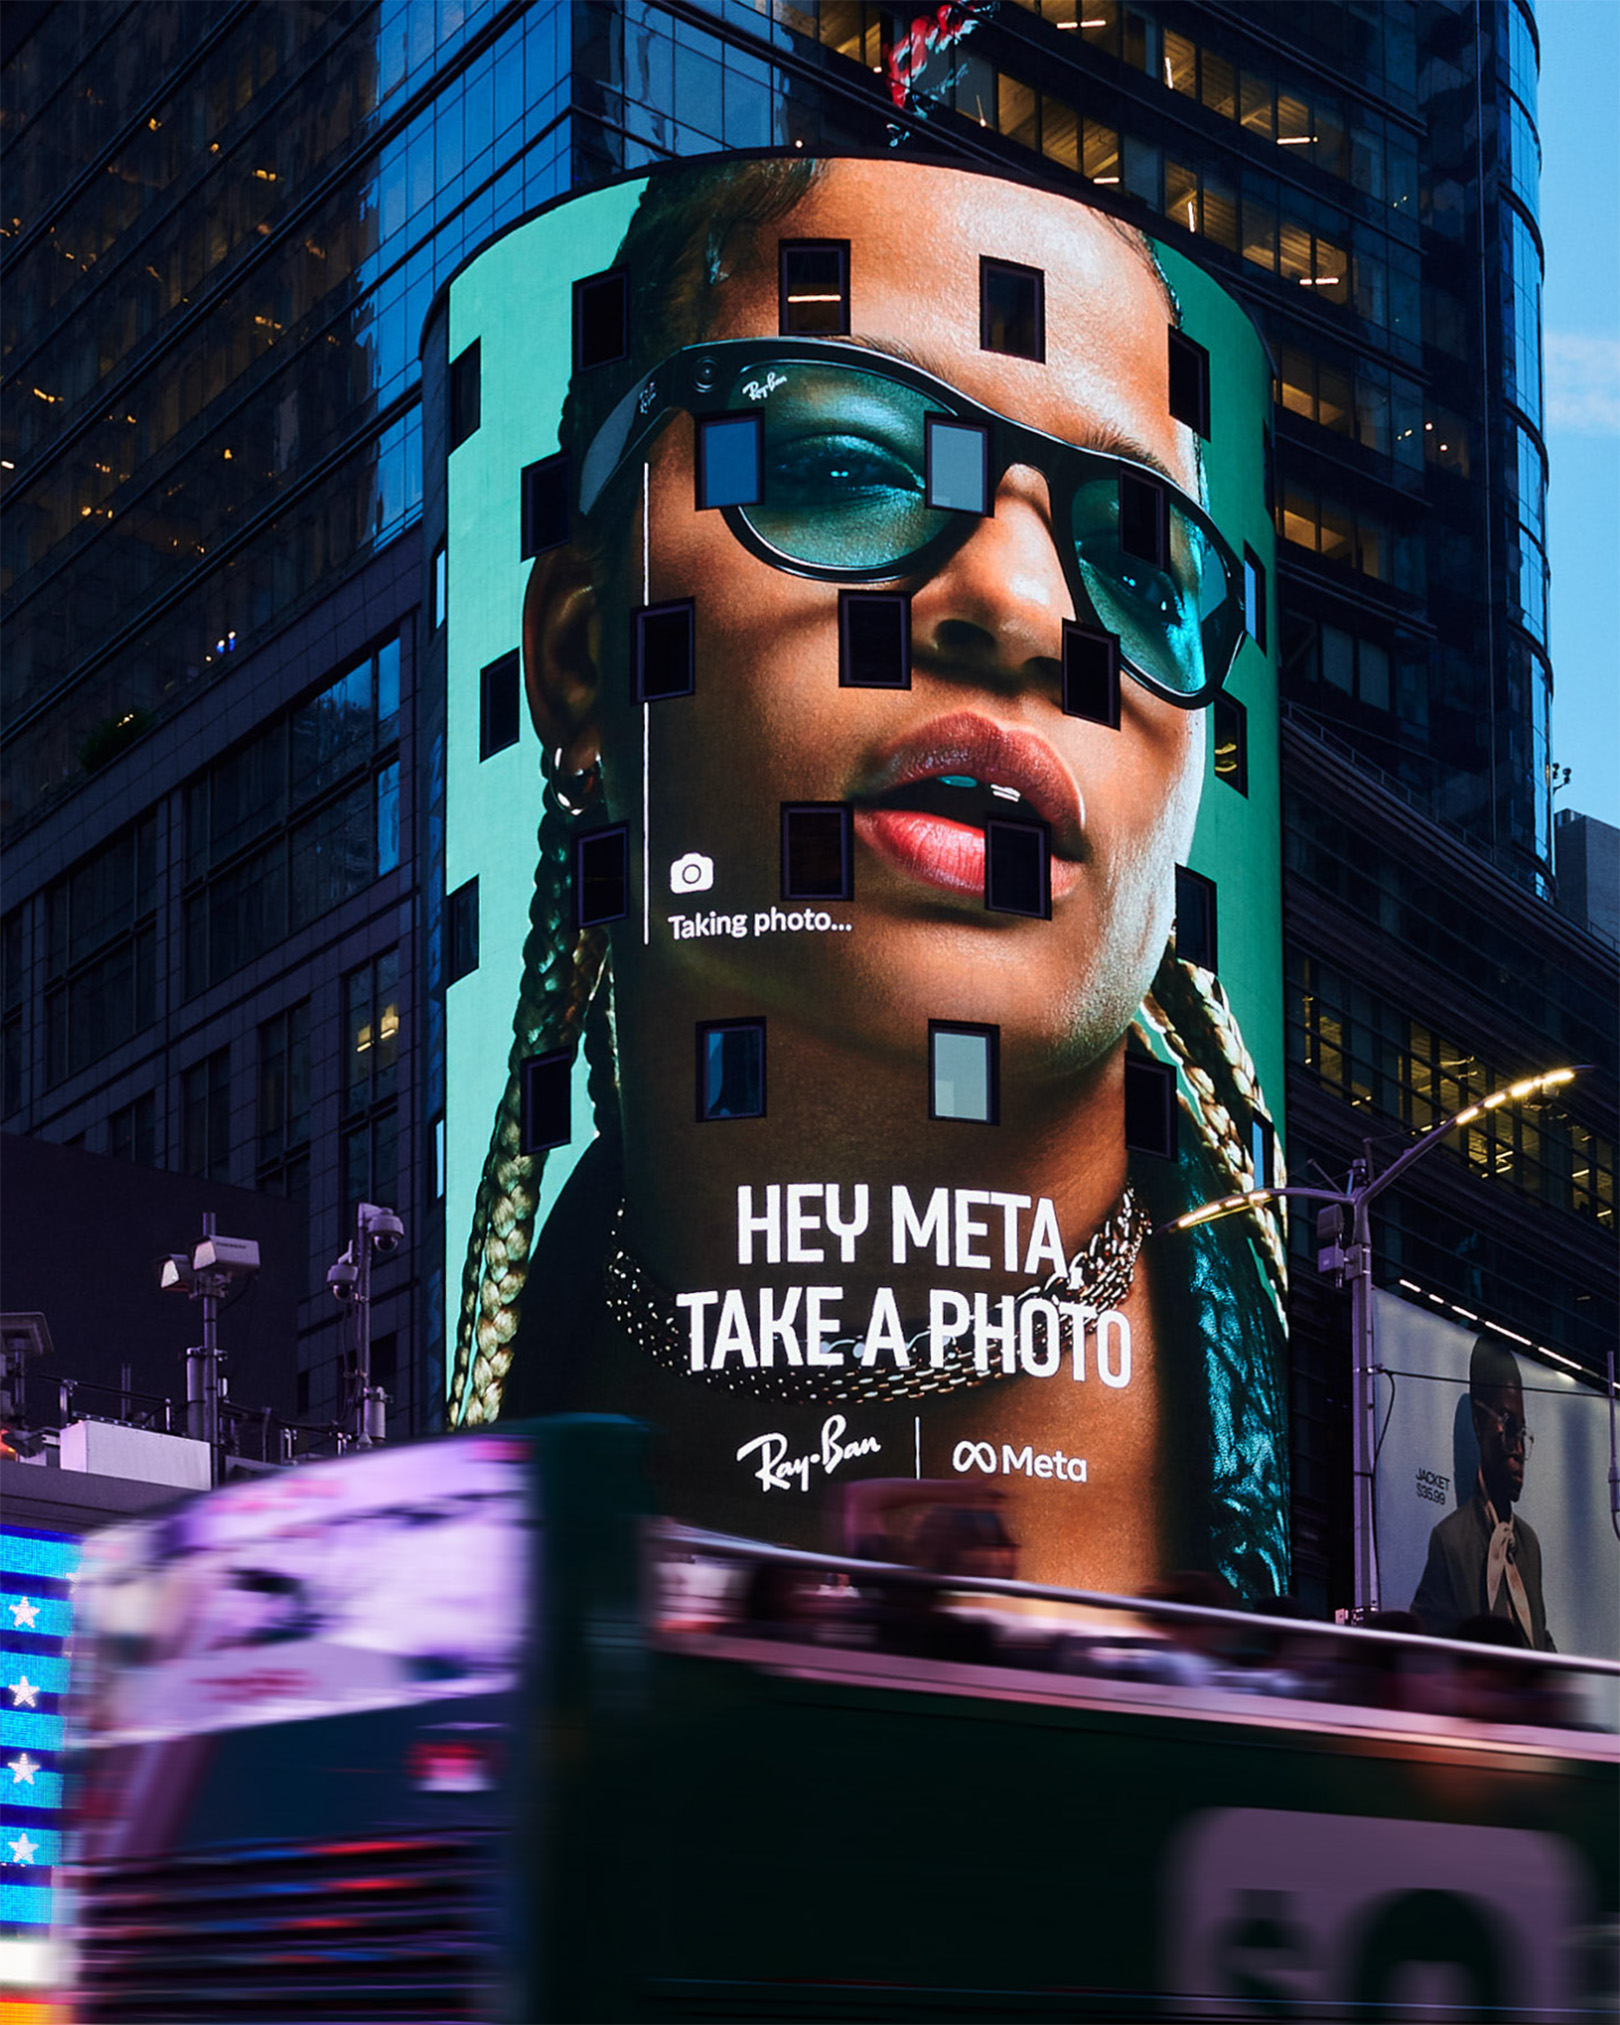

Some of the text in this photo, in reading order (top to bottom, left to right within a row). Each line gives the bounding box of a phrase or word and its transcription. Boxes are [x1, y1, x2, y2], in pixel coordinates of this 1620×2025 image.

[667, 905, 853, 940] Taking photo...
[737, 1183, 869, 1265] HEY
[676, 1286, 1133, 1389] TAKE A PHOTO
[1001, 1444, 1088, 1483] Meta
[1415, 1467, 1450, 1491] JACKET
